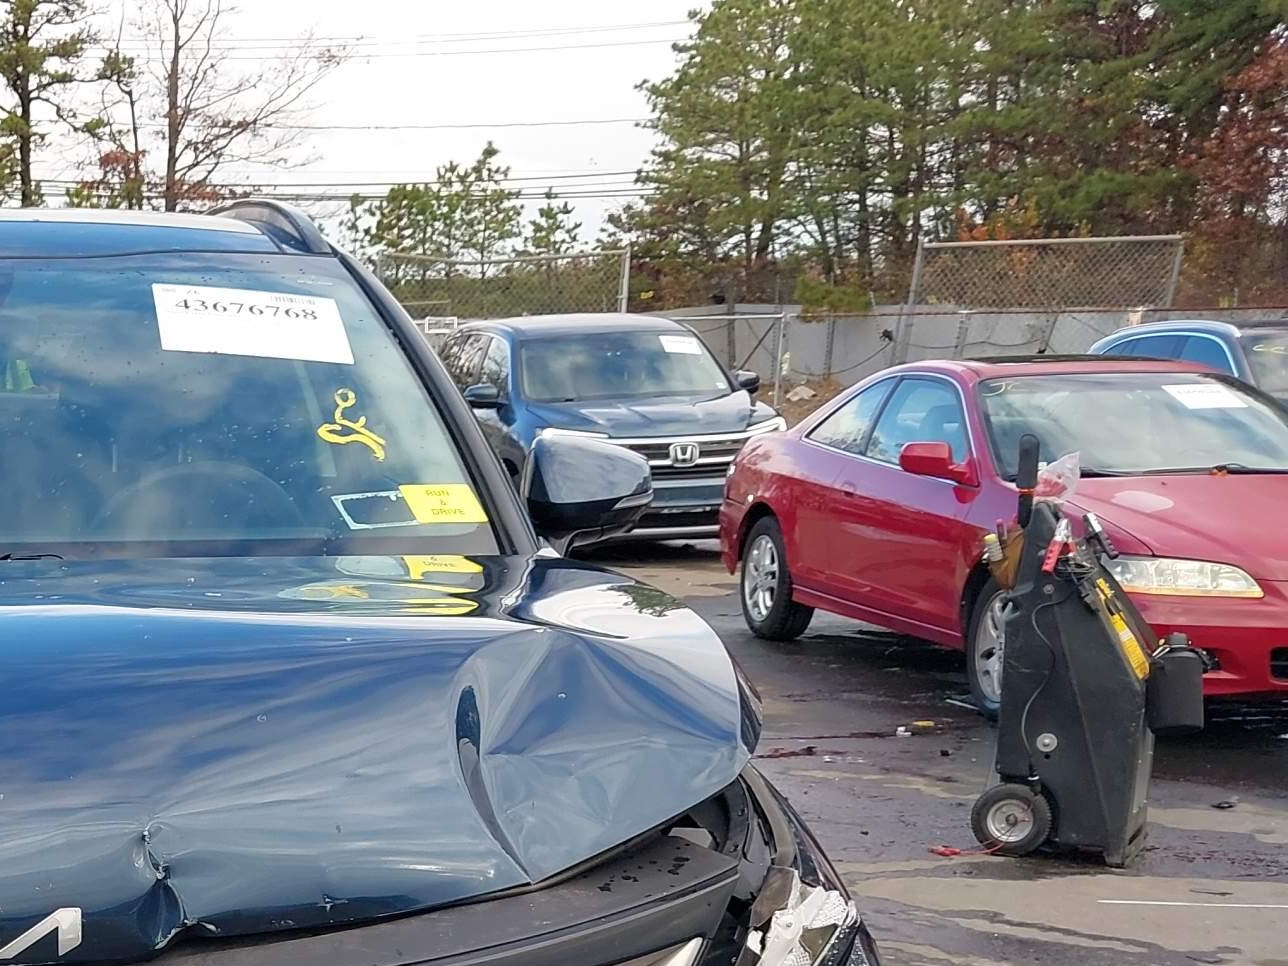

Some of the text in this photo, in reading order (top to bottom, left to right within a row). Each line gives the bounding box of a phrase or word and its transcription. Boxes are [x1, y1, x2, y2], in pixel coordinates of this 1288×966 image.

[175, 299, 318, 320] 43676768
[425, 489, 450, 497] RUN
[431, 507, 465, 516] DRIVE
